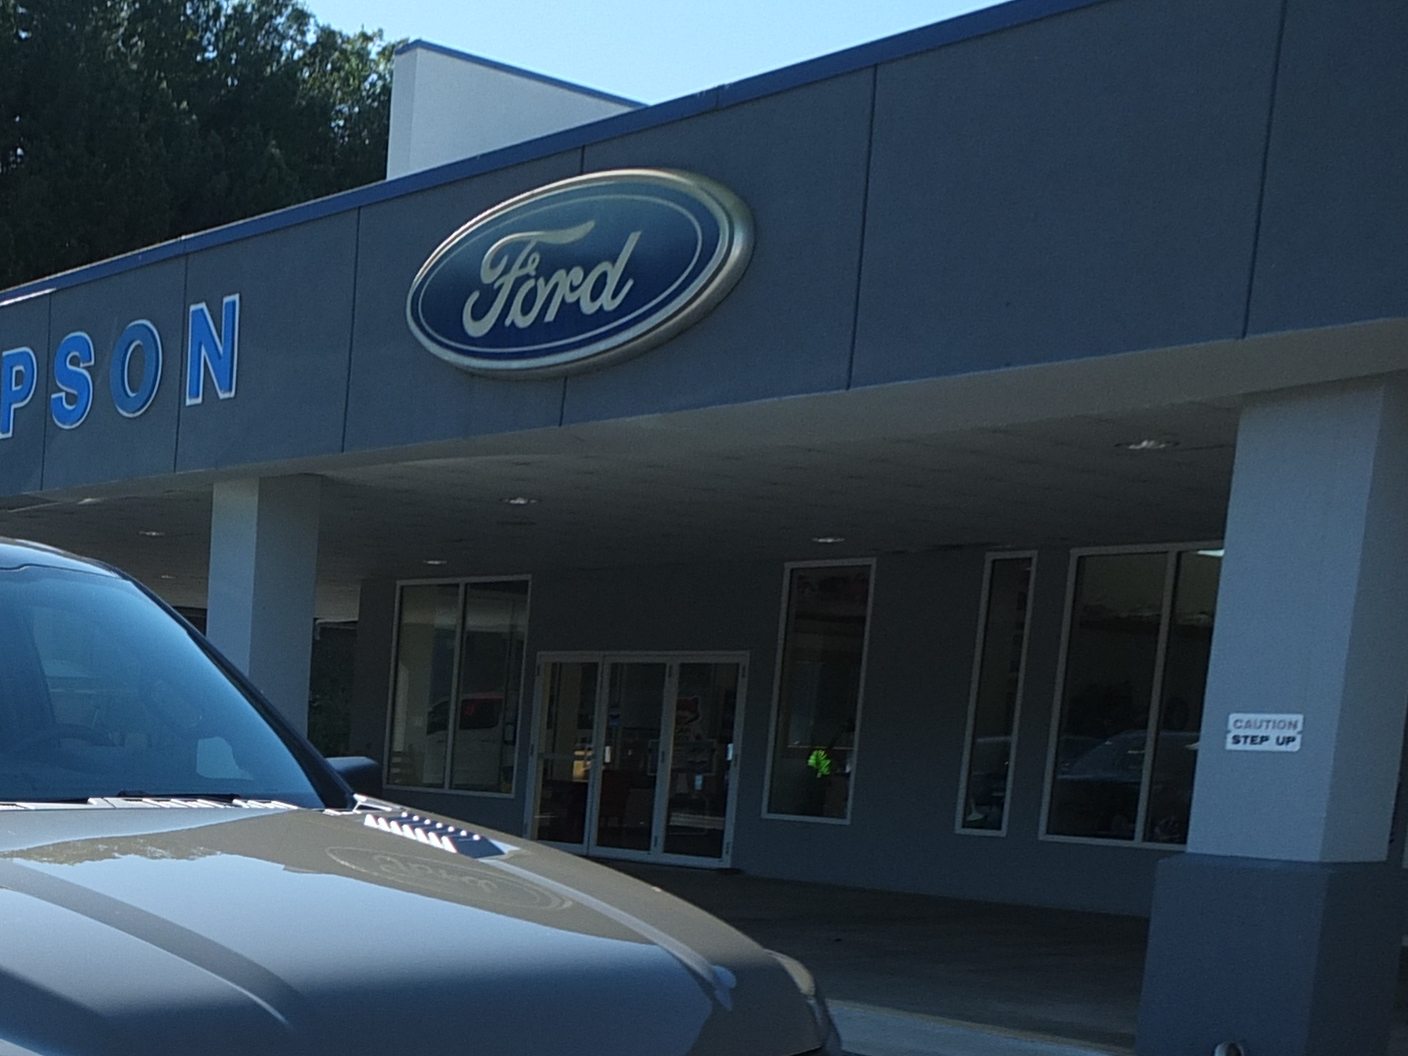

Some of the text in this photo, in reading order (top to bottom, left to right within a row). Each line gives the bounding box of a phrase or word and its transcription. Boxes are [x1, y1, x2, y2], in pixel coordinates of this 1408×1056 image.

[462, 220, 641, 337] Ford
[1233, 719, 1298, 731] CAUTION
[1232, 734, 1297, 746] STEP UP
